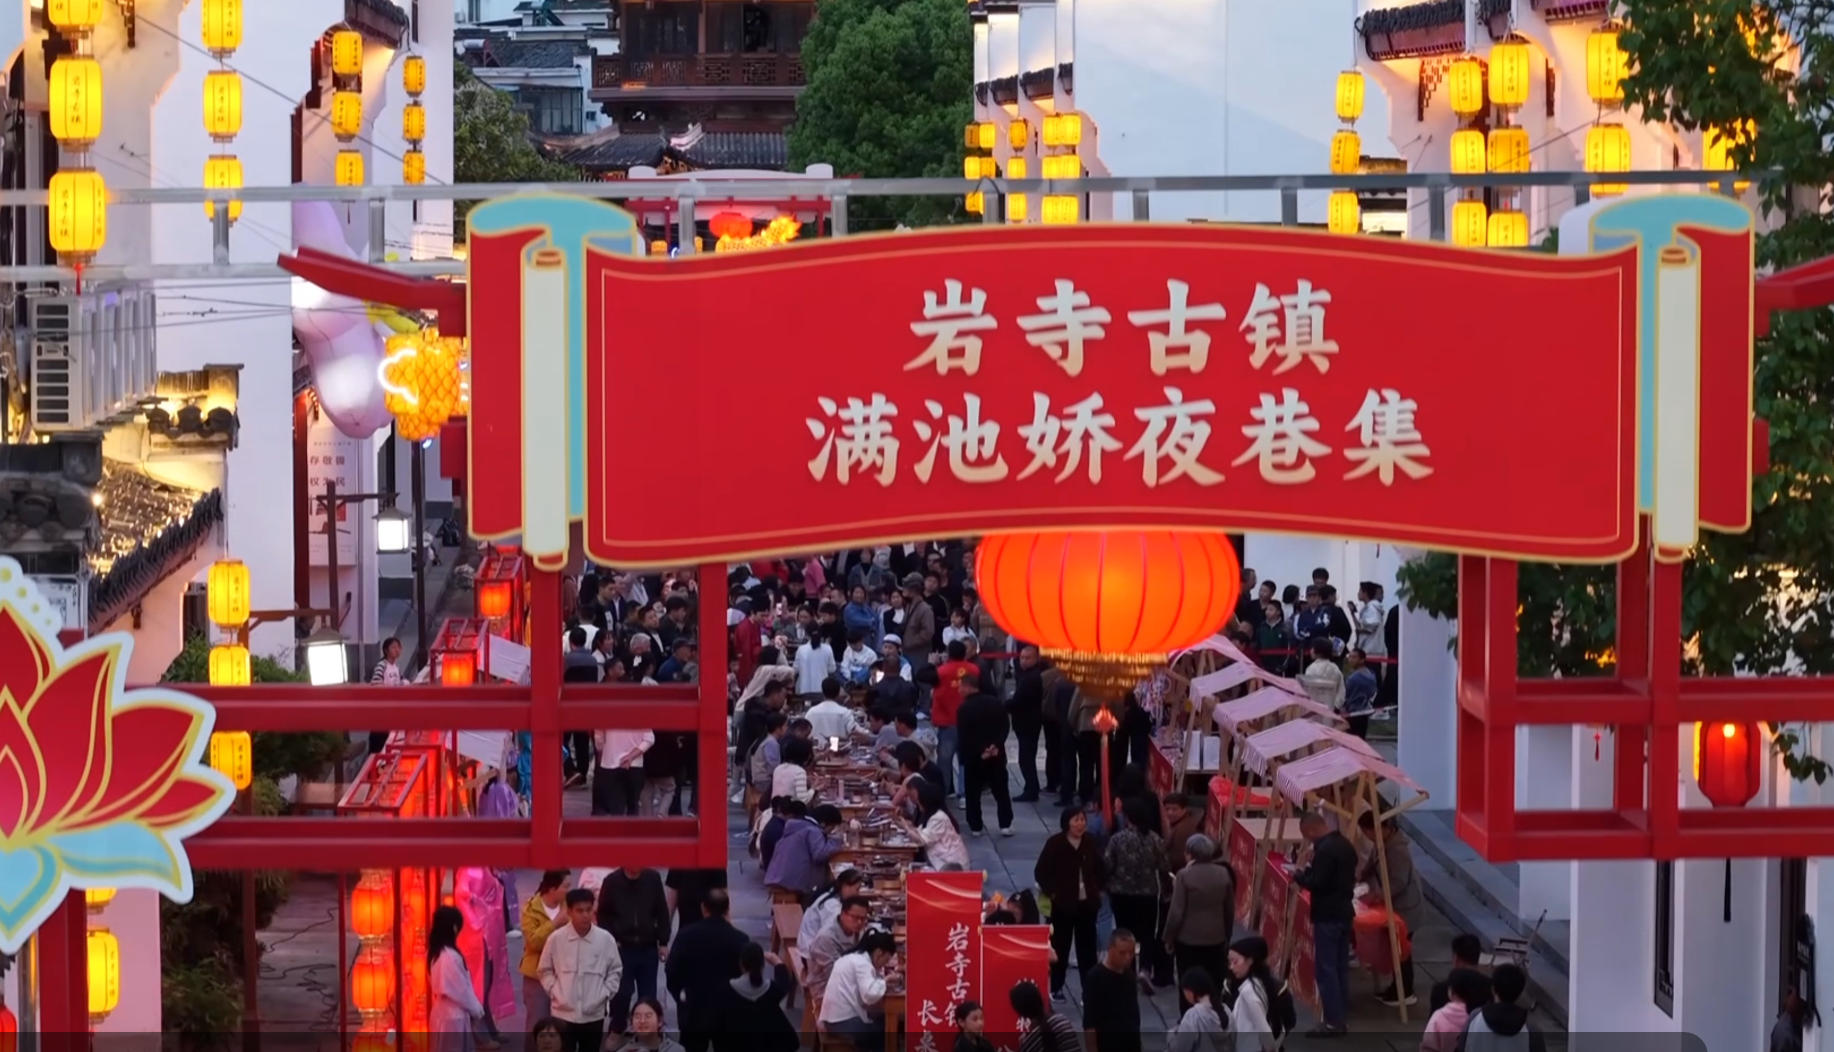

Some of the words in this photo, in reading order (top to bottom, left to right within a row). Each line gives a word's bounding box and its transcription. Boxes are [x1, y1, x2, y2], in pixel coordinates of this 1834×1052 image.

[904, 278, 1339, 376] 岩寺古镇
[805, 386, 1433, 487] 满池娇夜巷集
